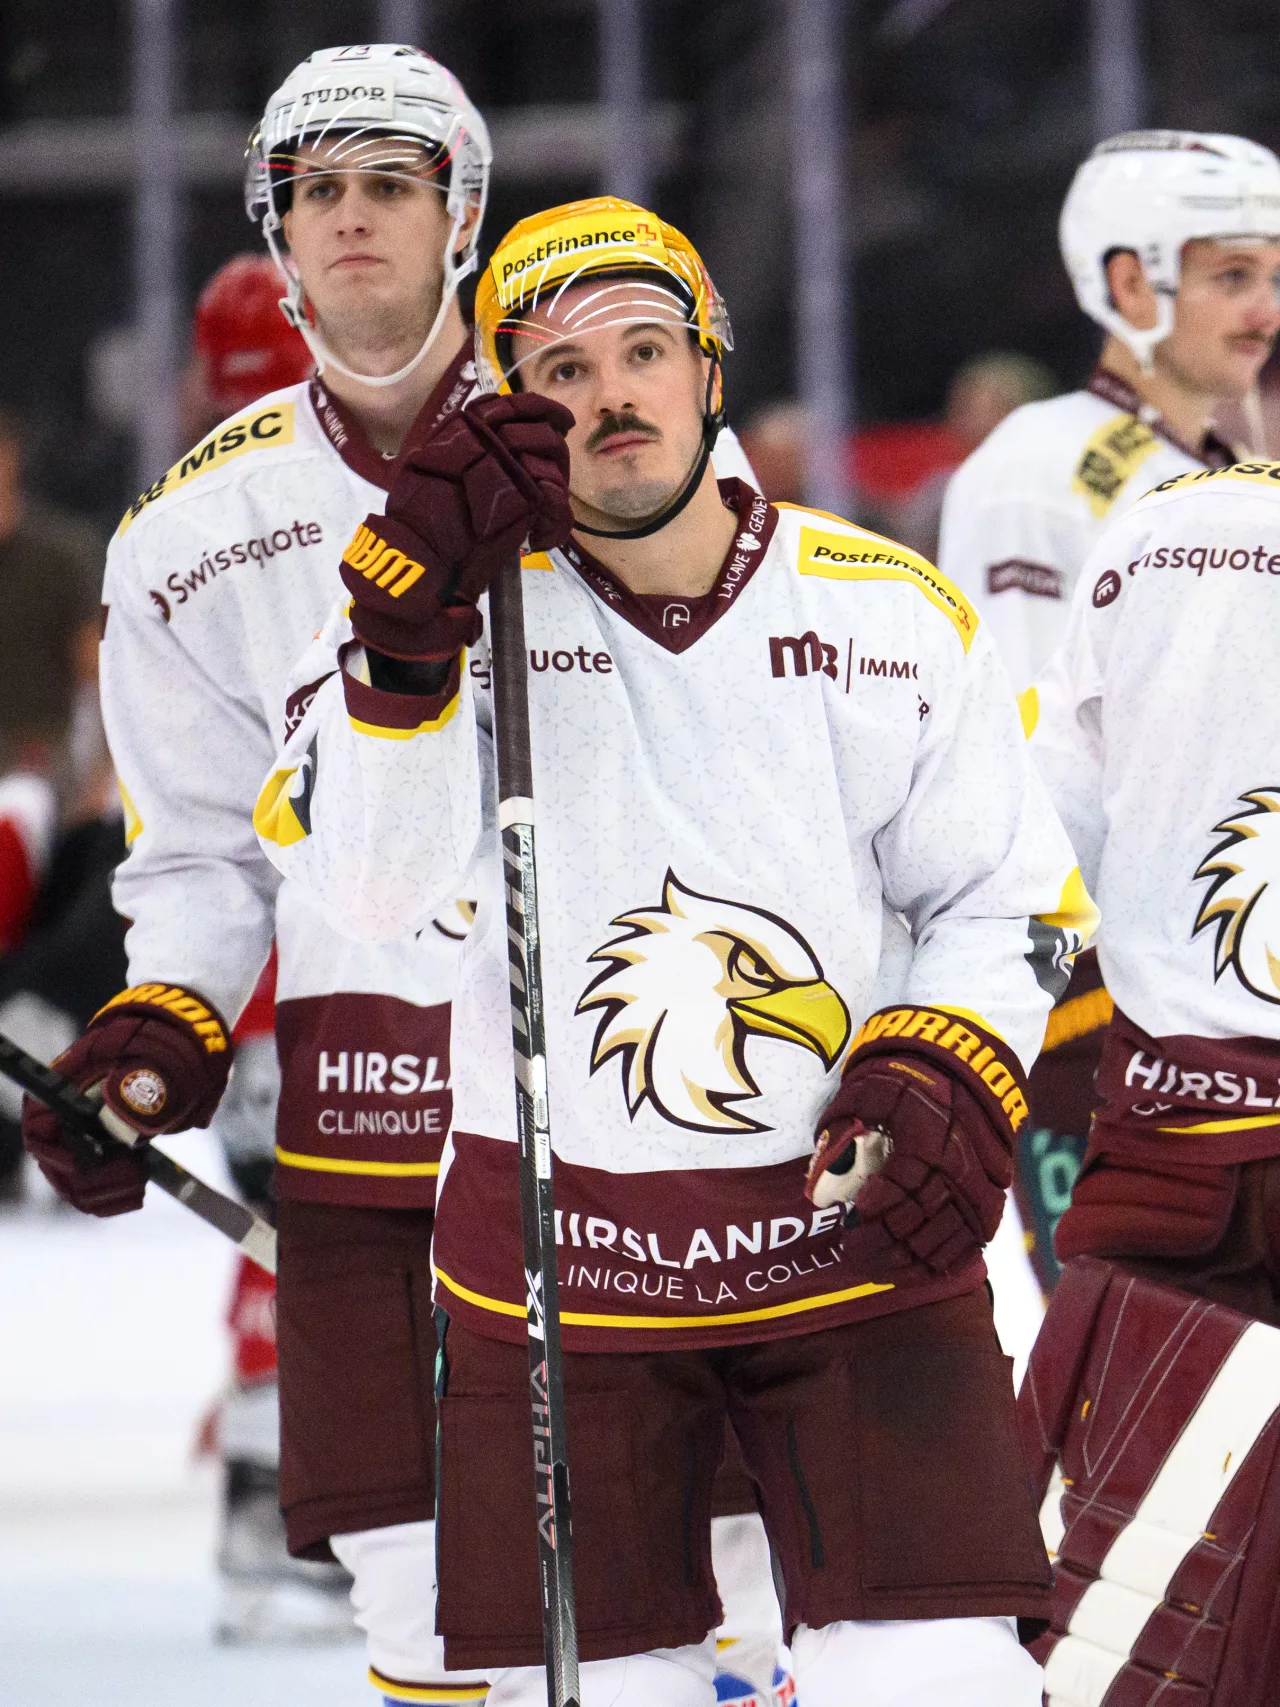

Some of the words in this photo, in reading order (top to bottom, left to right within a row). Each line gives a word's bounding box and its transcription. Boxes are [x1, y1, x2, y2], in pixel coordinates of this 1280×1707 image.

[302, 86, 386, 107] TUDOR
[502, 228, 635, 283] PostFinance
[179, 411, 283, 480] MSC
[167, 519, 324, 604] Swissquote
[726, 552, 751, 581] CAVE
[814, 545, 957, 608] PostFinance
[717, 577, 736, 600] LA
[768, 630, 839, 682] m3
[318, 1051, 453, 1095] HIRSL
[318, 1108, 442, 1135] CLINIQUE
[696, 1281, 738, 1305] LA
[745, 1246, 844, 1293] COLLI
